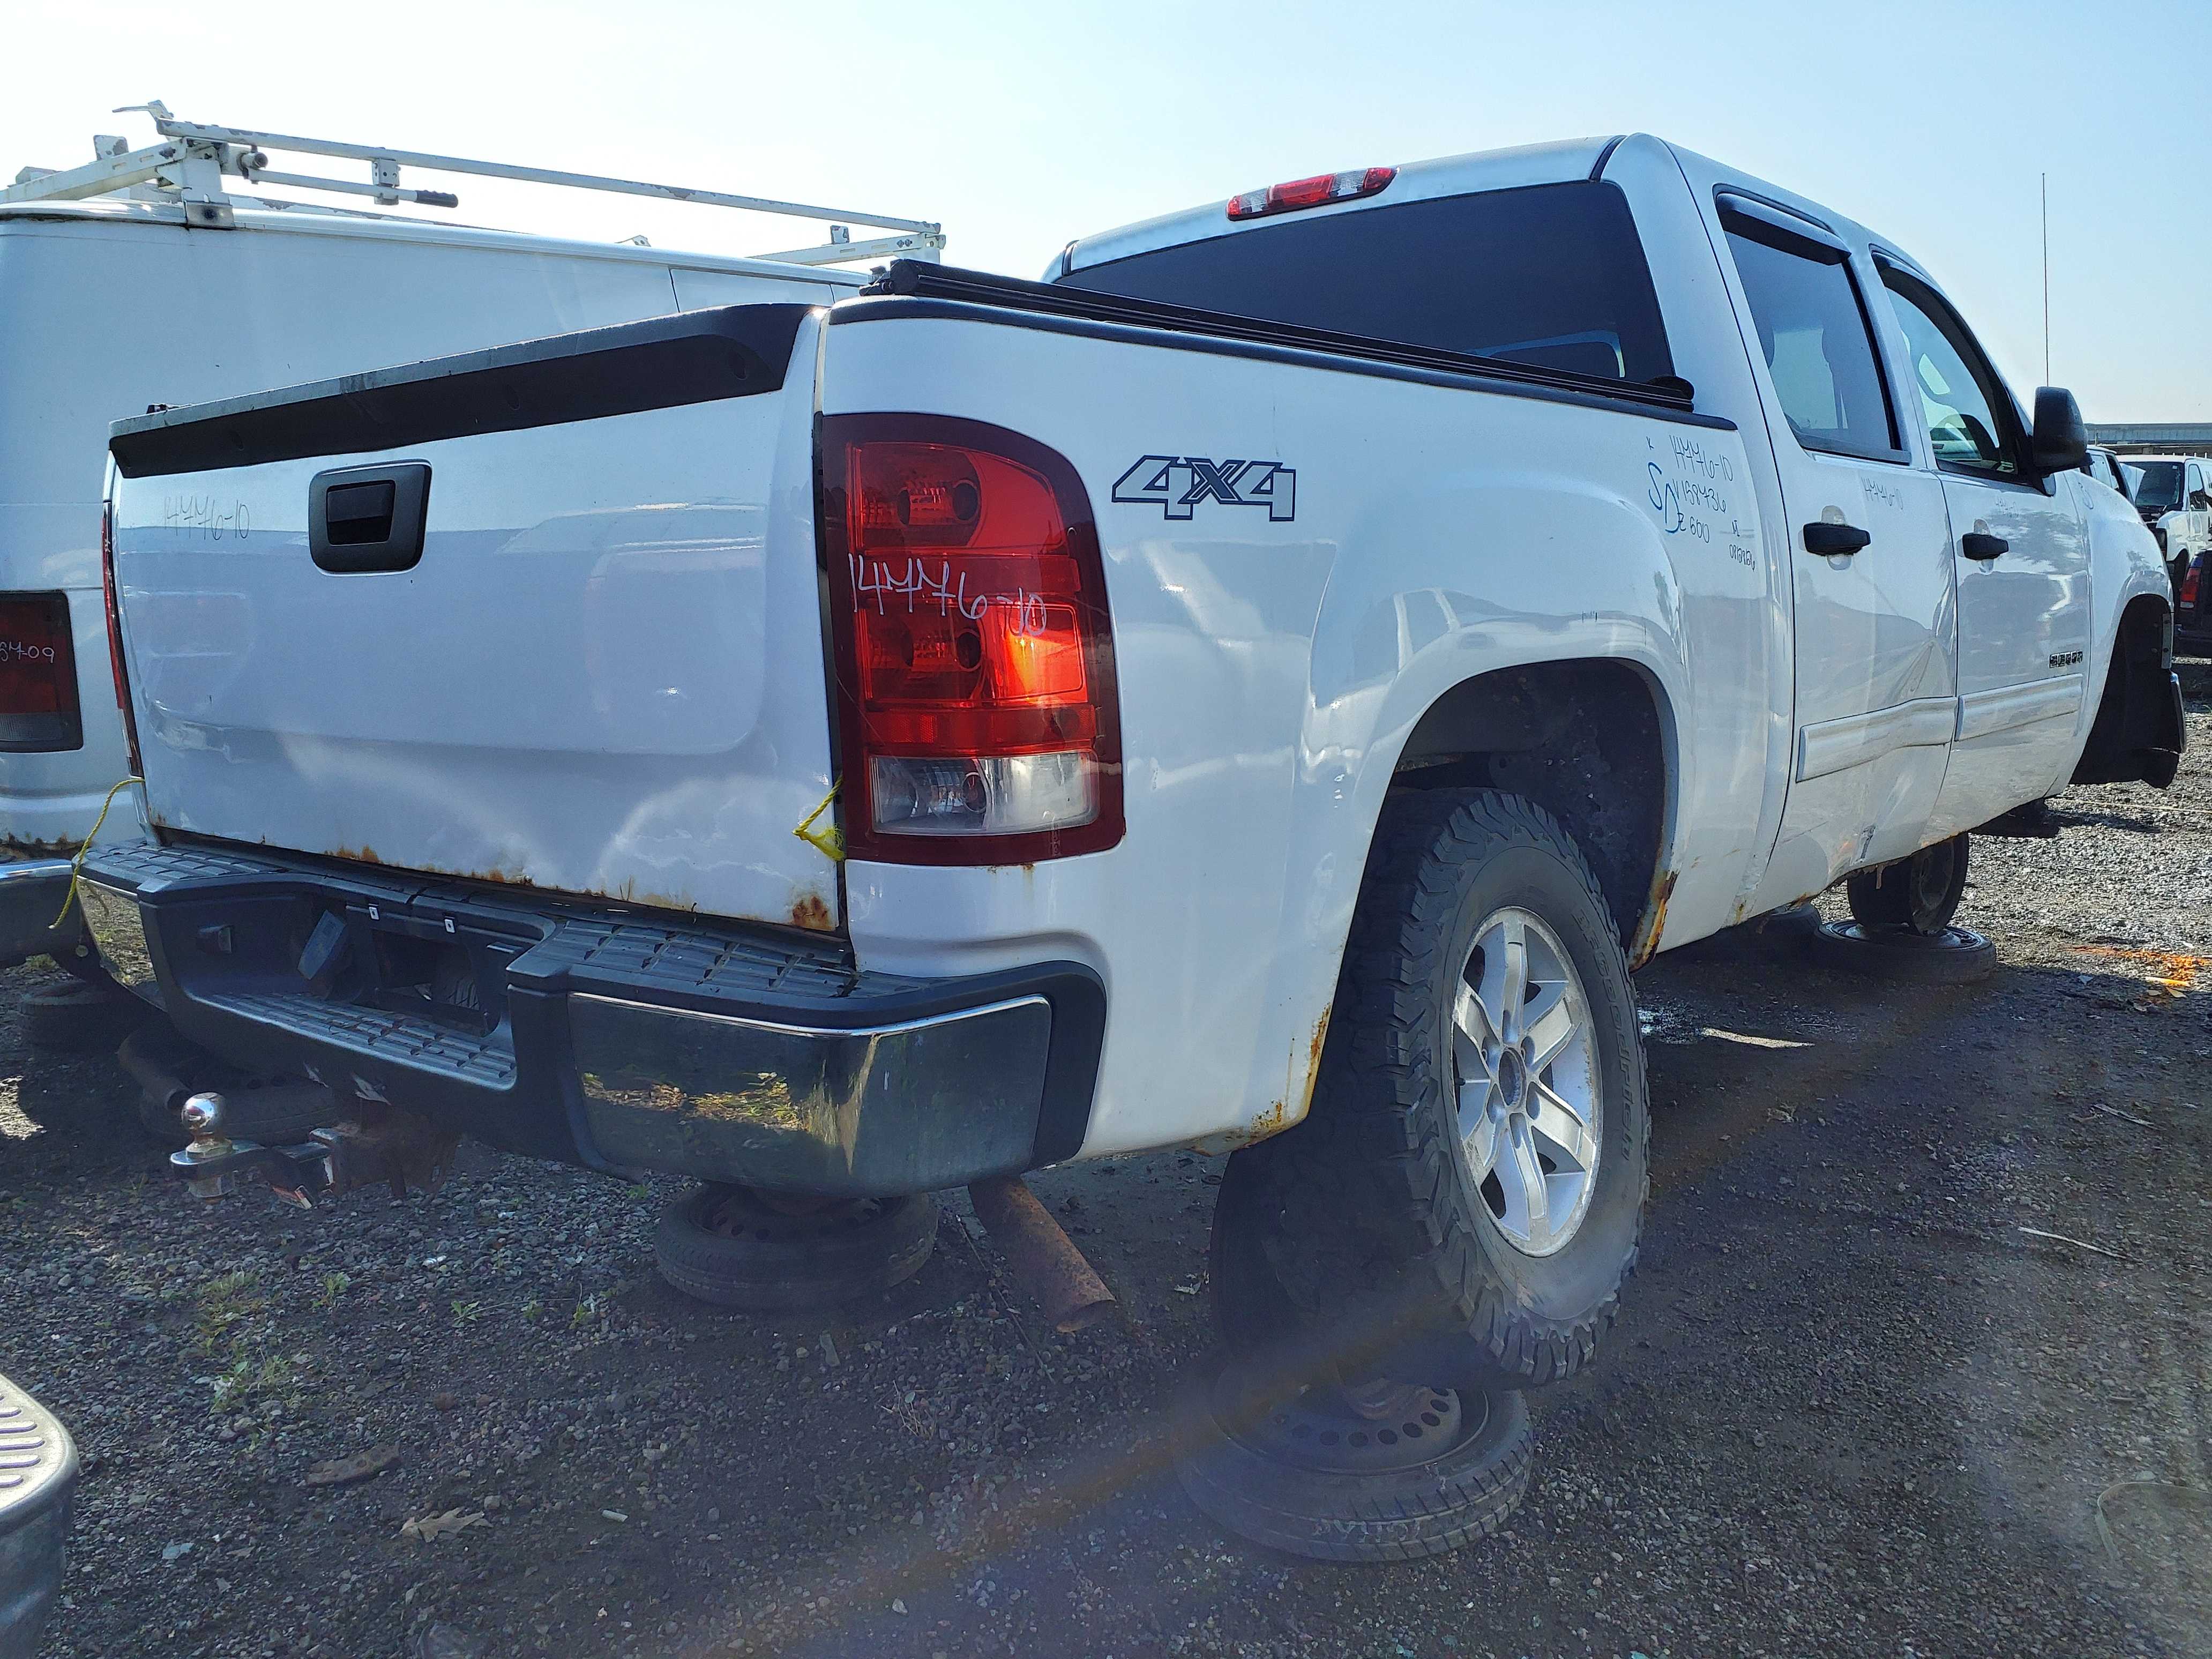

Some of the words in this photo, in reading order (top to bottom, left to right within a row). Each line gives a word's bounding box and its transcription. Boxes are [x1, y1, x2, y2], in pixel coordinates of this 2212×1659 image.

[1669, 435, 1733, 482] 14446-10
[164, 495, 250, 541] 14446-10
[848, 552, 1047, 637] 14446-10
